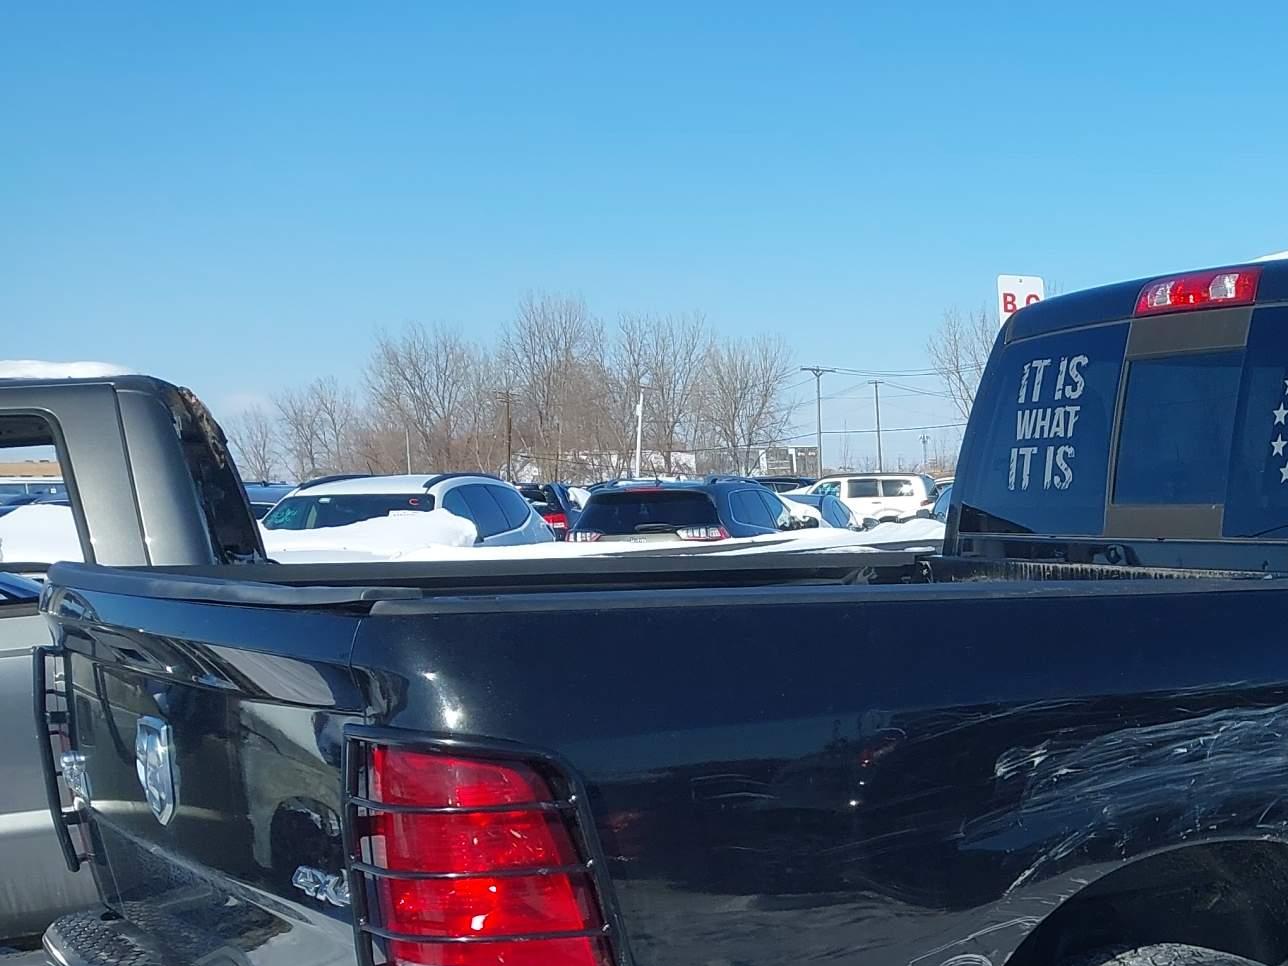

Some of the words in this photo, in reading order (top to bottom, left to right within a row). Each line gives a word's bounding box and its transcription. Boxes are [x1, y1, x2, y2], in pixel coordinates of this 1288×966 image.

[1018, 359, 1052, 404] IT
[1054, 355, 1089, 401] IS
[1016, 405, 1081, 441] WHAT
[1008, 446, 1038, 491] IT
[1043, 445, 1075, 490] IS
